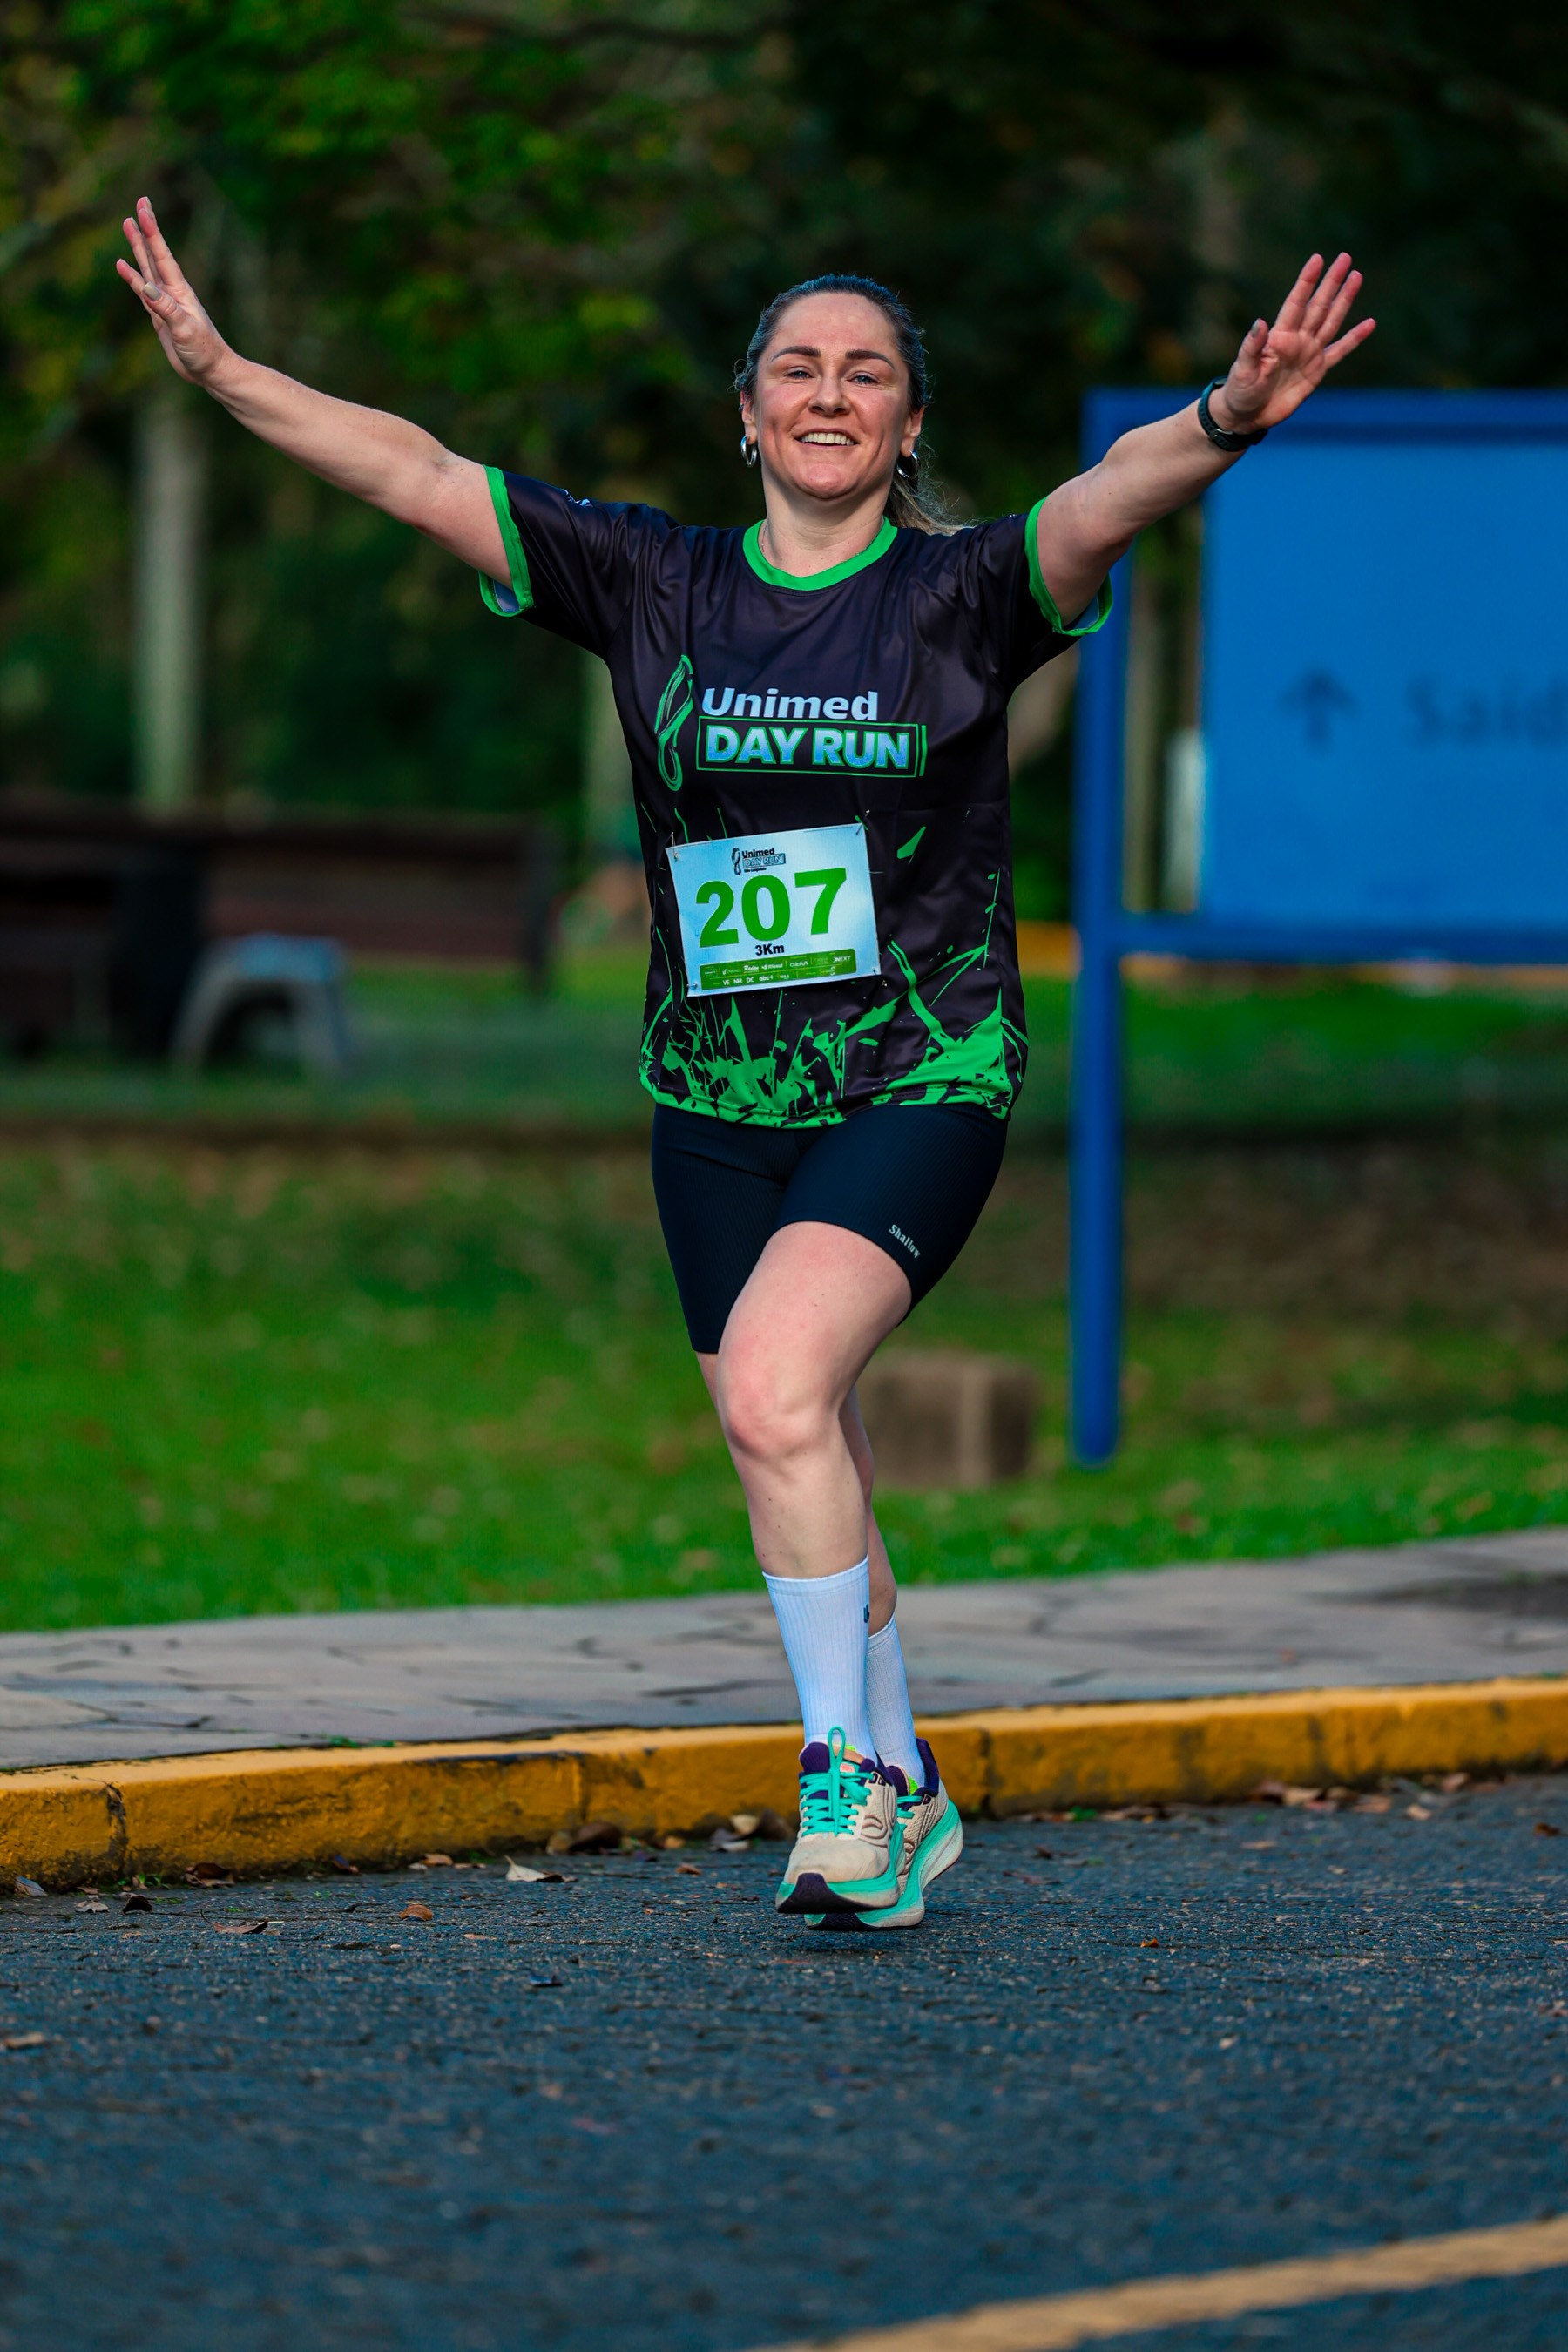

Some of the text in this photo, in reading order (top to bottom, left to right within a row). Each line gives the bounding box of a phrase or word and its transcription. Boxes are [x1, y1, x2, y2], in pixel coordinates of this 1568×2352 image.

[702, 687, 878, 721] Unimed
[705, 725, 910, 769] DAY RUN
[741, 847, 775, 859] Unimed
[743, 855, 783, 868] DAY RUN
[695, 867, 847, 948] 207
[754, 943, 785, 956] 3Km
[889, 1224, 921, 1259] Shallow
